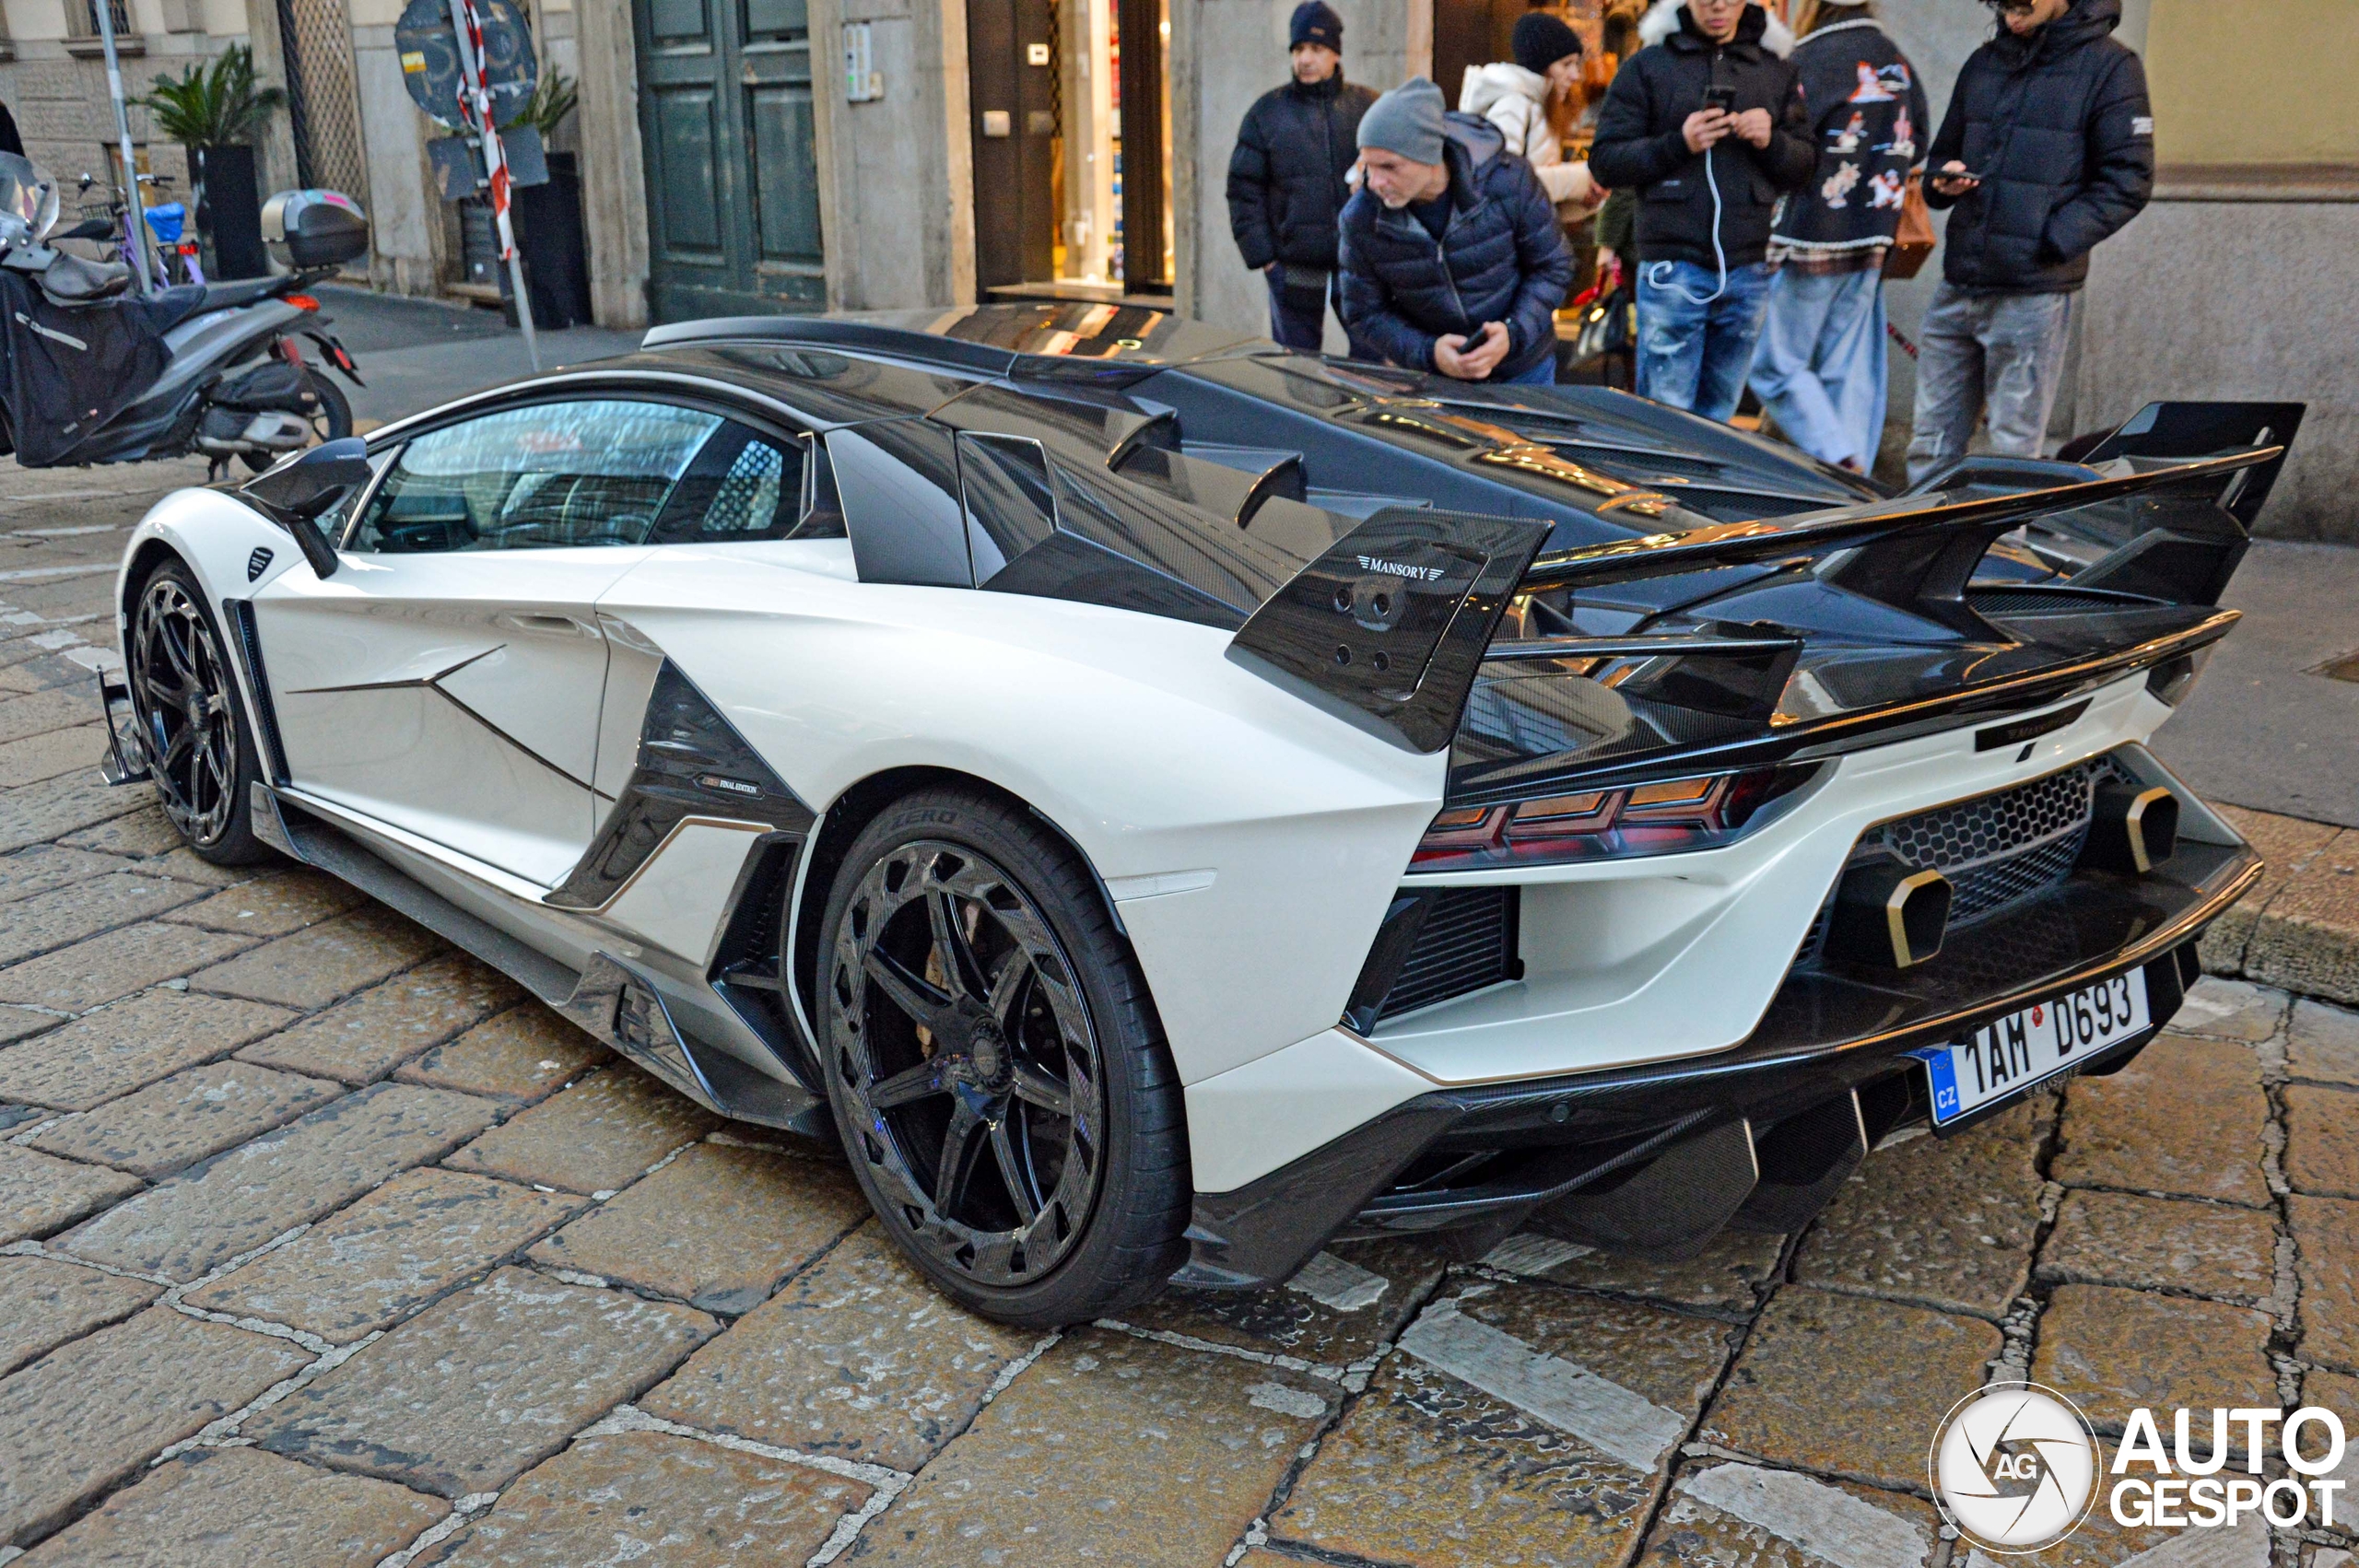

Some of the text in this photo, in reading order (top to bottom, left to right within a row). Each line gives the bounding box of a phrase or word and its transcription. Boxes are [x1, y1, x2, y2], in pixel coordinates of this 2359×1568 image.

[1369, 557, 1428, 579] MANSORY
[720, 779, 735, 790] FINAL
[735, 783, 757, 794] EDITION
[1965, 975, 2131, 1094] 1AM D693
[1937, 1085, 1957, 1110] CZ
